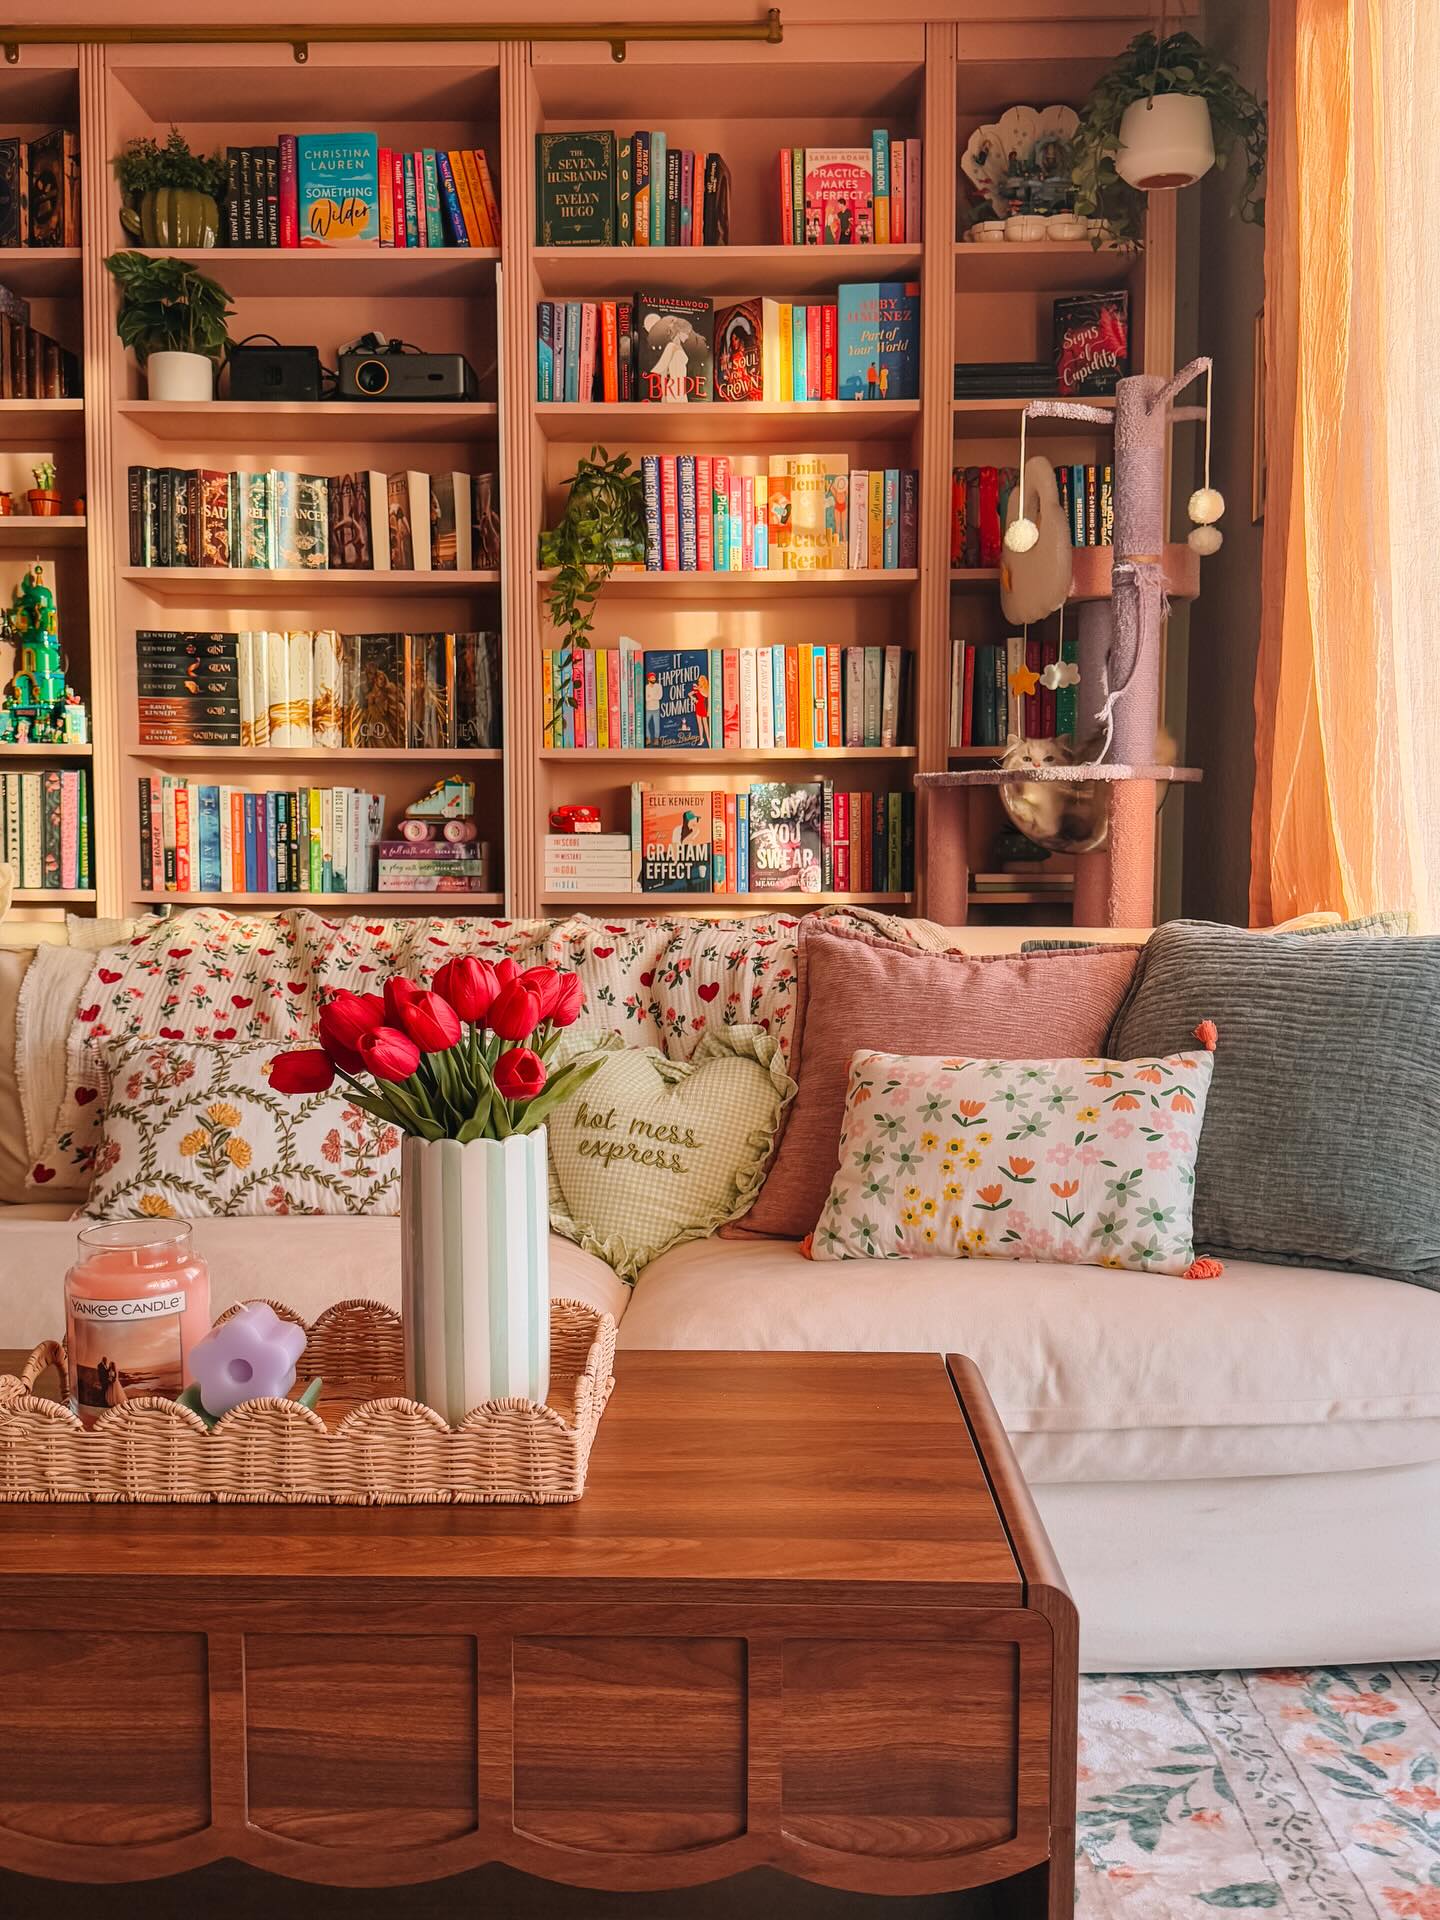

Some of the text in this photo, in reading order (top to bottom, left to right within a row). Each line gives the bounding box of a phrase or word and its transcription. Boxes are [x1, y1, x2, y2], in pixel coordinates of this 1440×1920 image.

[305, 149, 370, 159] CHRISTINA
[876, 151, 885, 168] RULE
[311, 160, 364, 171] LAUREN
[441, 160, 451, 178] Novel
[558, 159, 596, 170] SEVEN
[812, 168, 866, 178] PRACTICE
[547, 170, 608, 183] HUSBANDS
[820, 179, 858, 189] MAKES
[876, 171, 885, 190] BOOK
[306, 187, 372, 198] SOMETHING
[573, 182, 582, 193] of
[815, 191, 864, 200] PERFECT
[555, 192, 600, 205] EVELYN
[243, 199, 251, 239] TATE JAMES
[311, 197, 372, 236] Wilder
[406, 200, 416, 219] GAME
[561, 206, 594, 218] HUGO
[230, 201, 238, 240] TATE JAMES
[269, 205, 277, 245] TATE JAMES
[659, 298, 710, 309] HAZELWOOD
[861, 327, 900, 342] Part of
[1062, 326, 1099, 349] Signs
[877, 339, 909, 353] World
[1079, 344, 1090, 361] of
[733, 352, 759, 370] SOUL
[1063, 348, 1117, 386] Cupidity
[641, 371, 708, 400] BRIDE
[719, 377, 759, 398] CROWN
[786, 460, 827, 476] Emily
[664, 460, 675, 507] HAPPY PLACE
[698, 461, 708, 508] HAPPY PLACE
[715, 460, 727, 521] Happy Place
[683, 487, 693, 511] STORY
[664, 513, 676, 536] EMILY
[683, 518, 693, 539] EMILY
[698, 515, 710, 562] EMILY HENRY
[777, 530, 838, 548] Beach
[782, 549, 834, 570] Read
[673, 653, 683, 670] IT
[830, 647, 839, 665] BOOK
[208, 663, 231, 672] GLEAM
[658, 665, 700, 687] HAPPENED
[830, 667, 839, 692] LOVERS
[669, 684, 686, 701] ONE
[660, 699, 697, 719] SUMMER
[335, 791, 343, 806] DOES
[649, 797, 705, 806] ELLE KENNEDY
[770, 798, 801, 819] SAY
[824, 788, 832, 833] DIRTY CURVE
[768, 823, 802, 843] YOU
[647, 843, 709, 862] GRAHAM
[756, 848, 814, 870] SWEAR
[647, 862, 693, 880] EFFECT
[574, 1102, 703, 1149] hot mess
[579, 1139, 690, 1173] express
